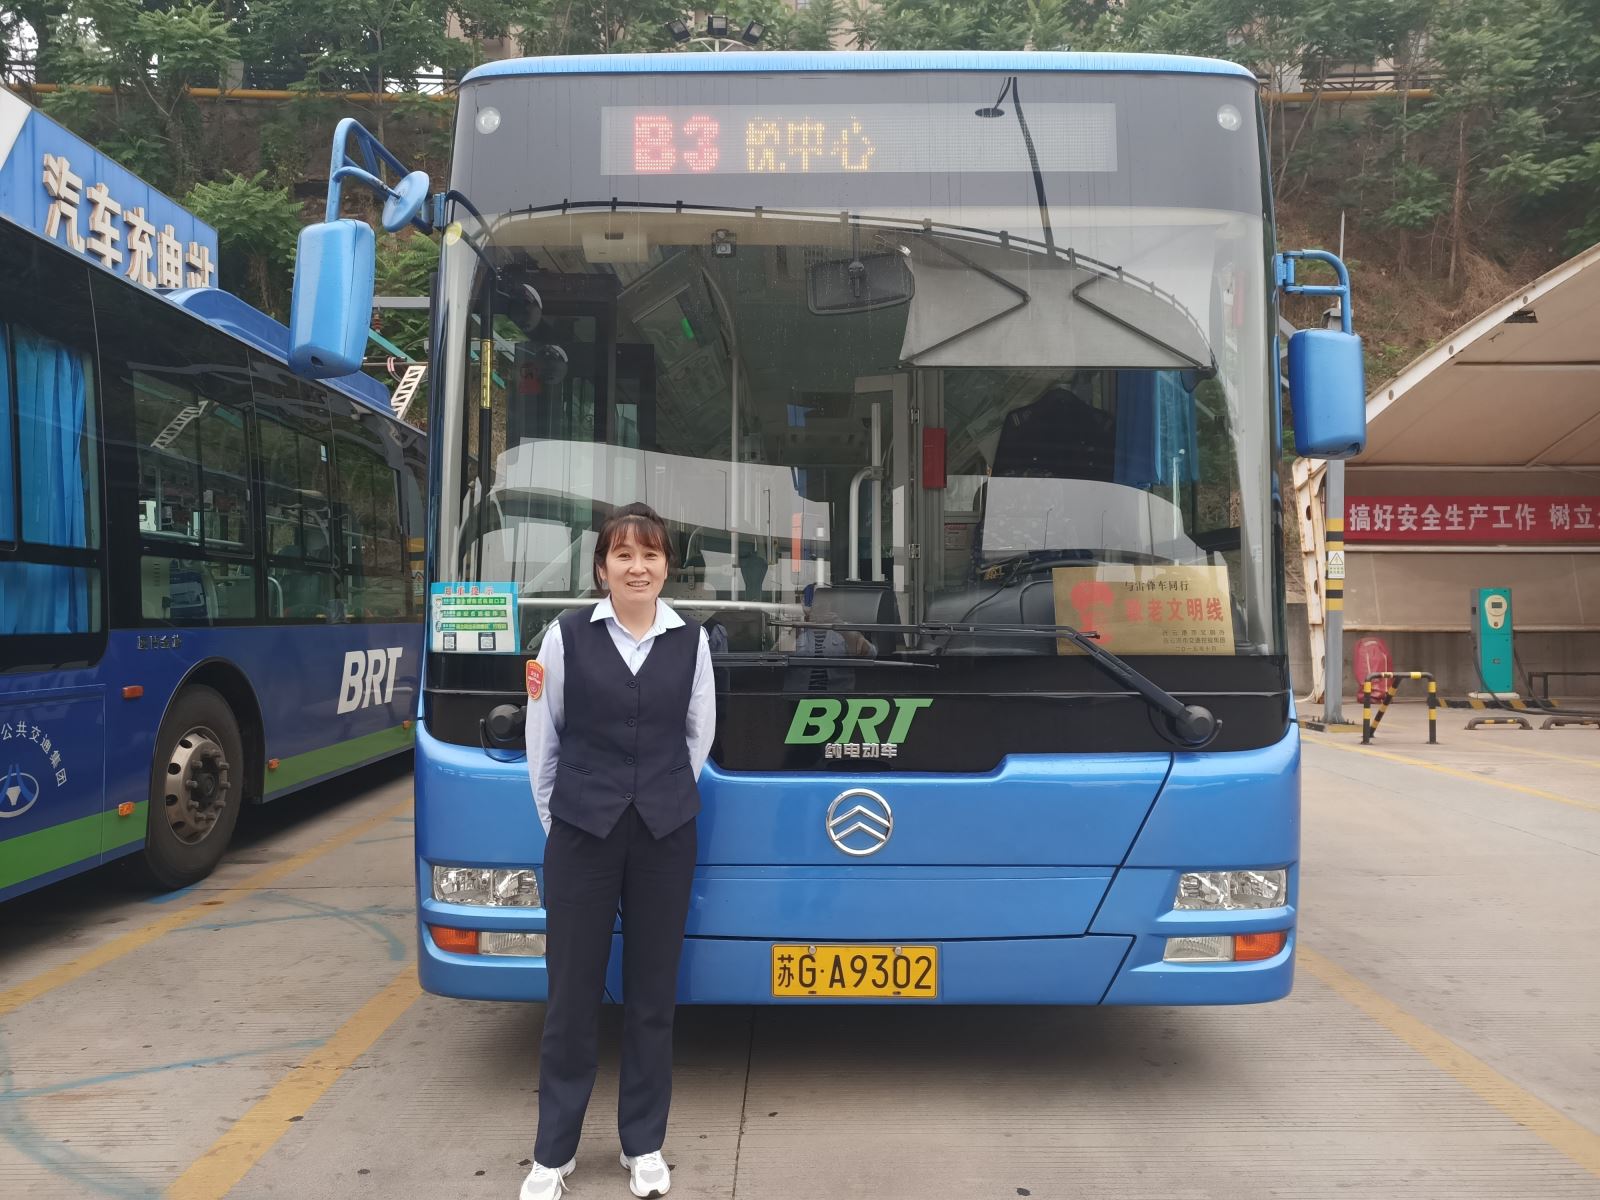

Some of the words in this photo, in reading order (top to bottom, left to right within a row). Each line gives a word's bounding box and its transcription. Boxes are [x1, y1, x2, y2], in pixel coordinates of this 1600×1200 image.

[632, 114, 720, 173] B3
[1349, 503, 1537, 532] 搞好安全生产工作
[1549, 503, 1600, 532] 树立
[337, 647, 403, 715] BRT
[784, 698, 934, 745] BRT
[0, 720, 68, 787] 公共交通集团
[824, 742, 898, 759] 纯电动车
